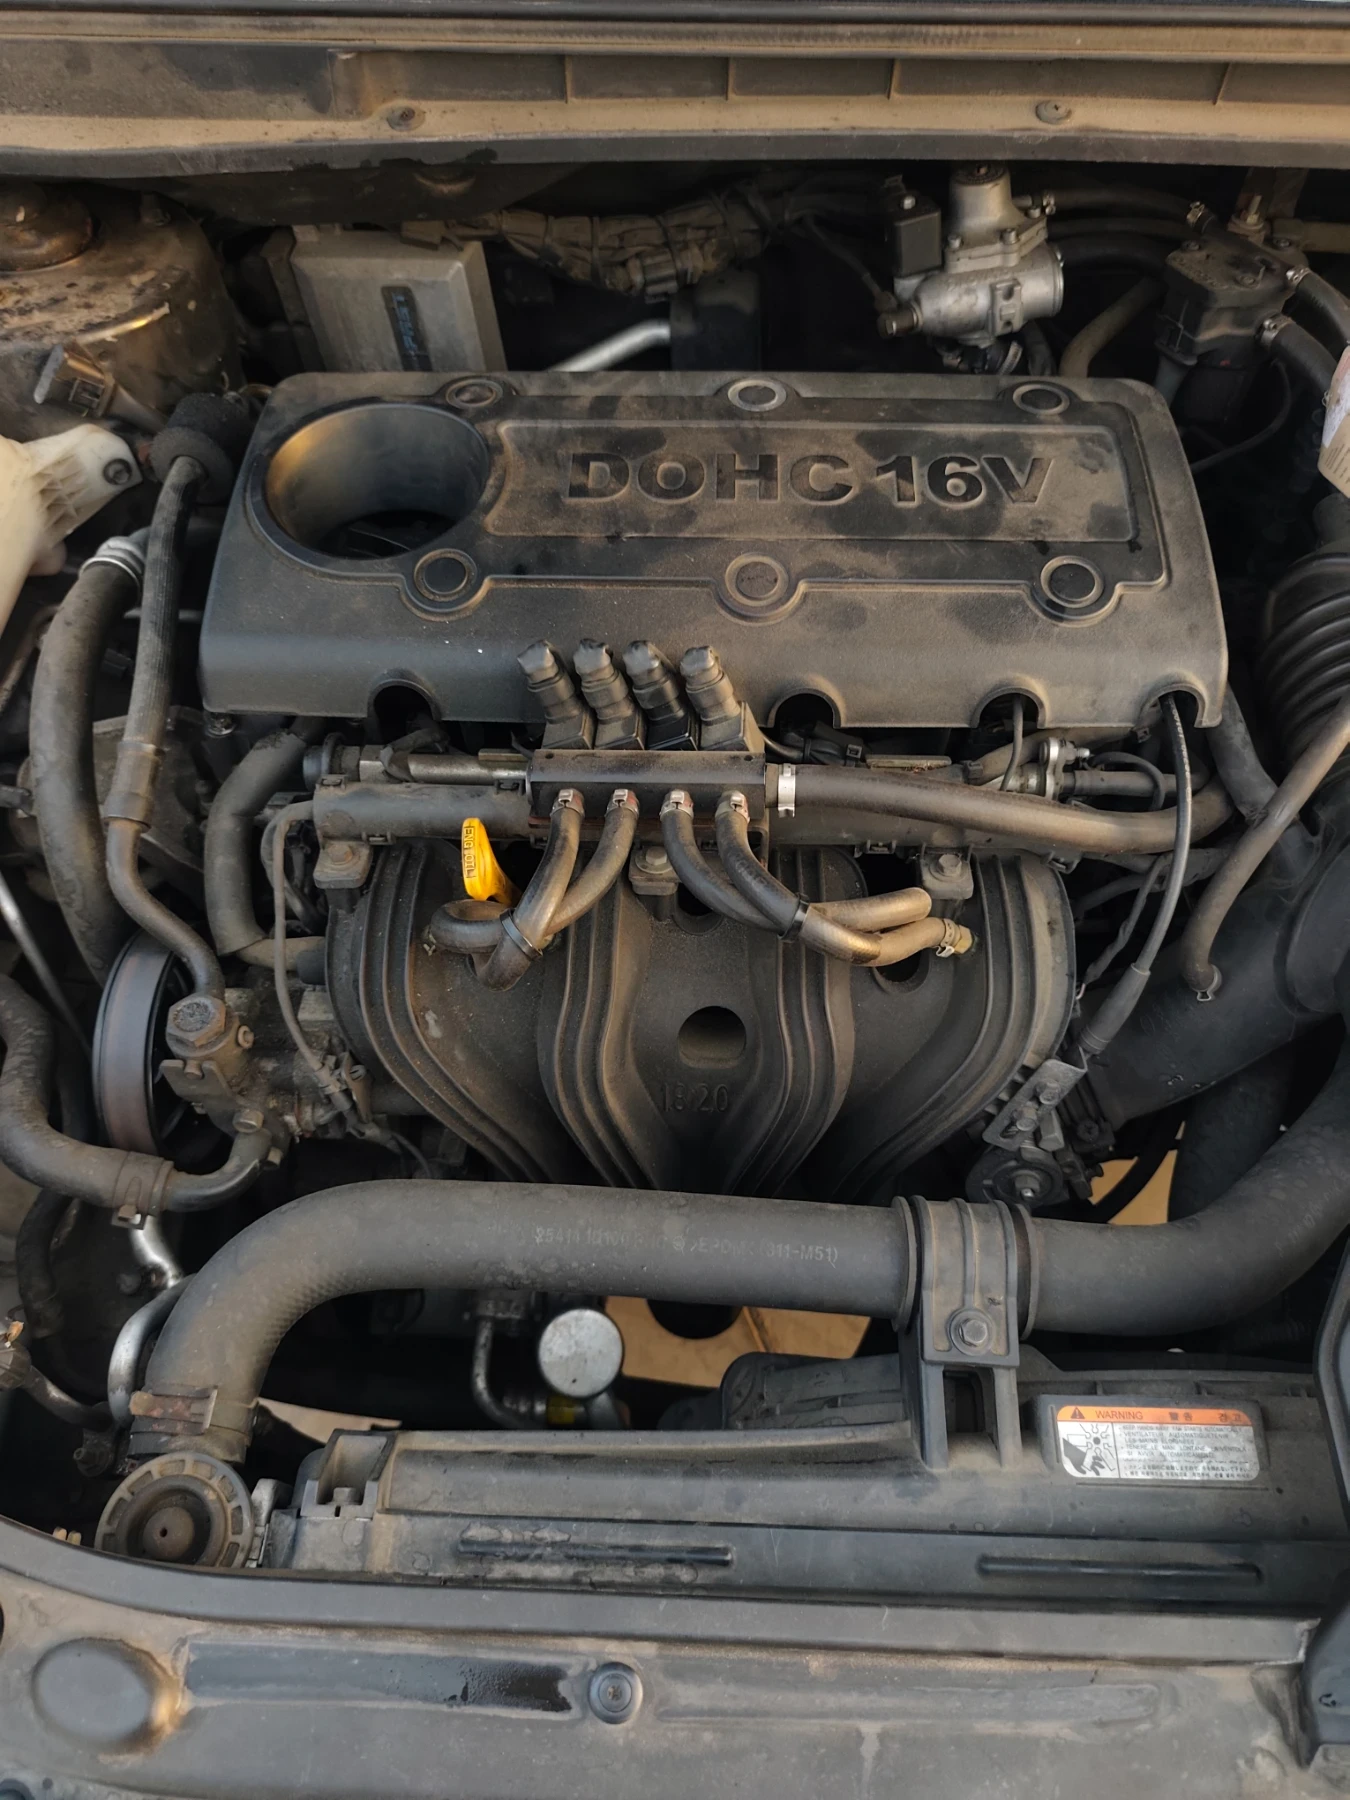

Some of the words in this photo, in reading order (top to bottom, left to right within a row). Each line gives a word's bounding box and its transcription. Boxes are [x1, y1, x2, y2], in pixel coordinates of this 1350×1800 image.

[566, 452, 858, 507] DOHC
[876, 455, 1056, 509] 16V
[464, 826, 475, 849] ENG
[465, 854, 476, 877] OIL
[1095, 1410, 1144, 1421] WARNING
